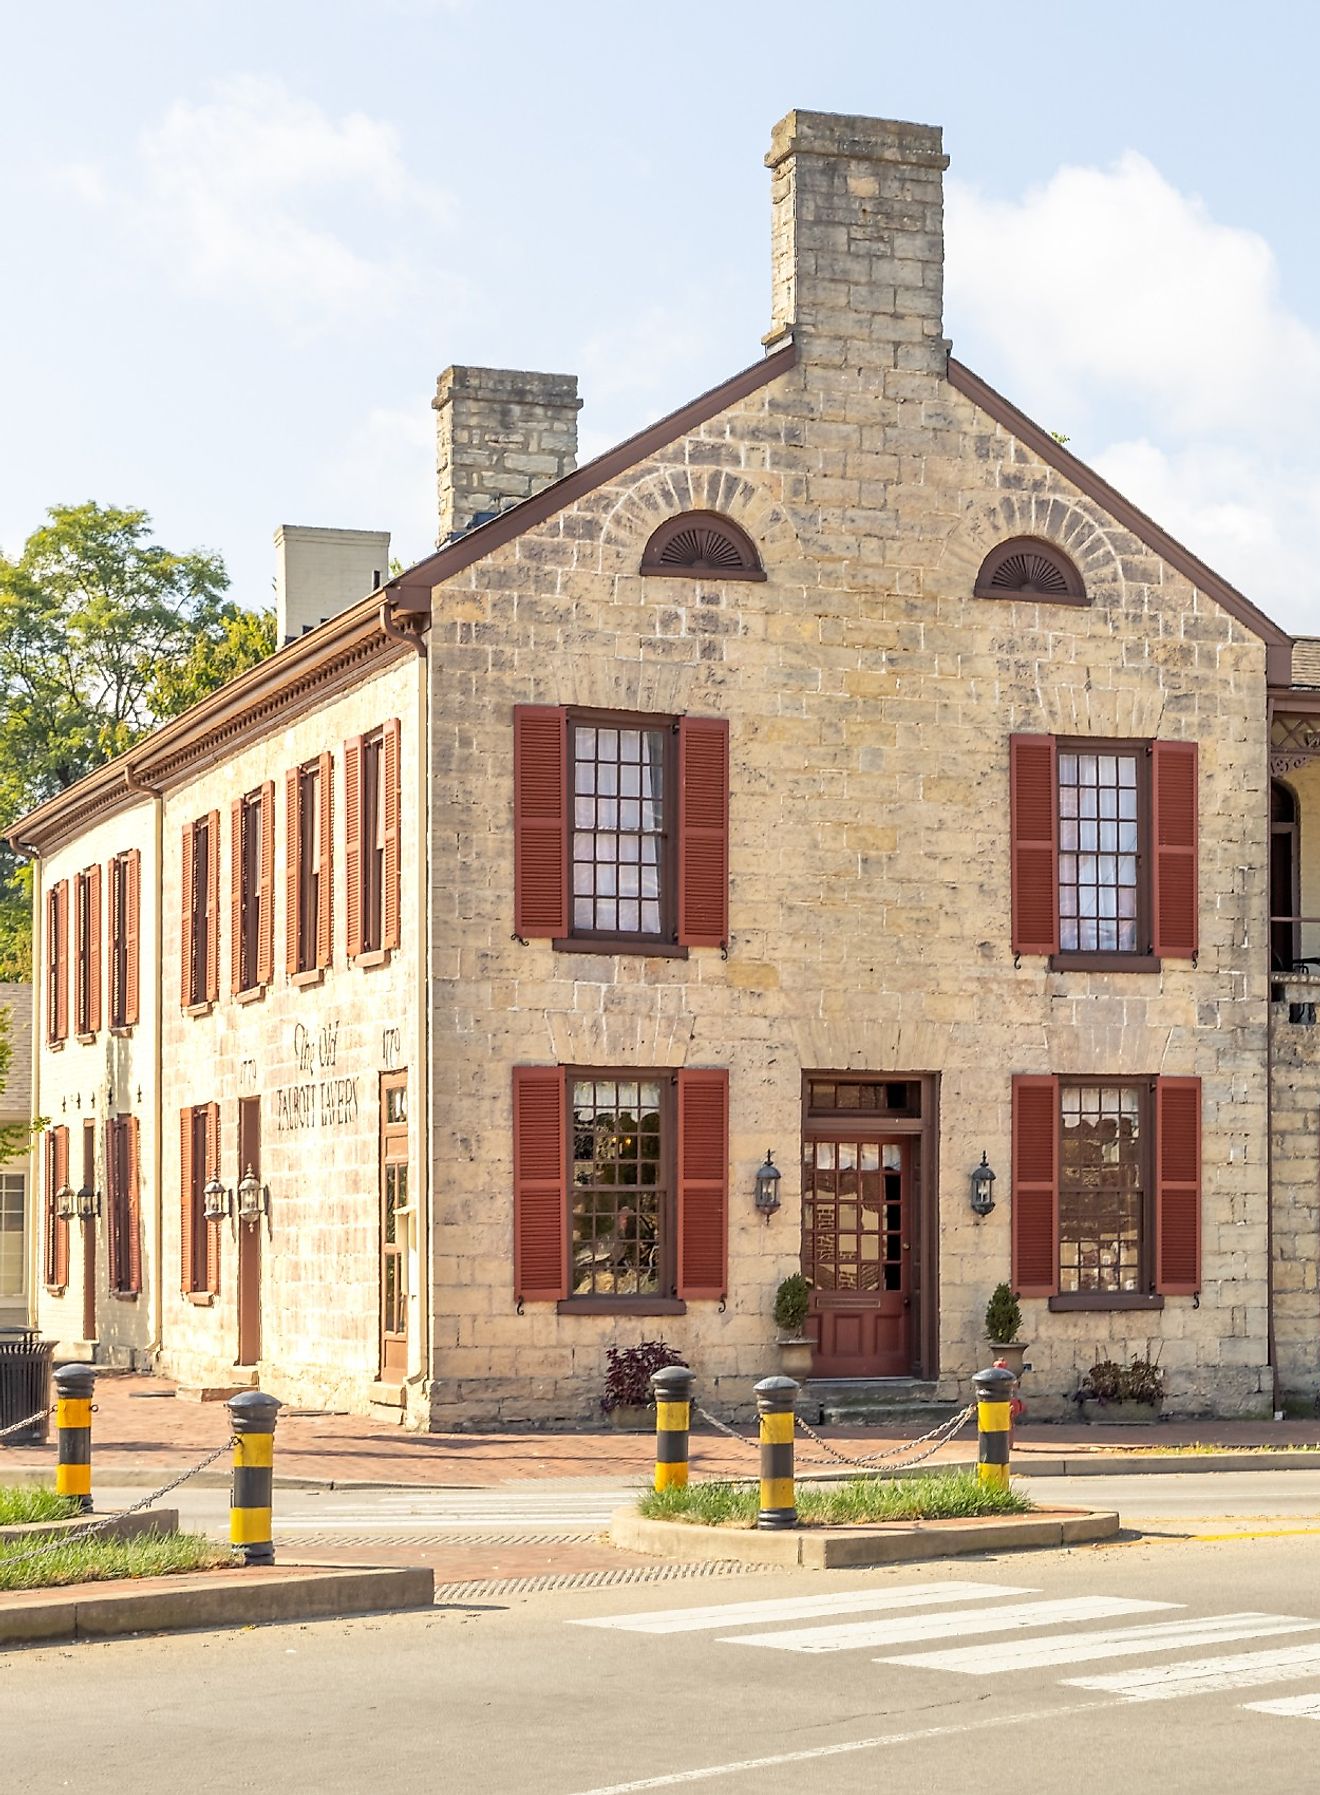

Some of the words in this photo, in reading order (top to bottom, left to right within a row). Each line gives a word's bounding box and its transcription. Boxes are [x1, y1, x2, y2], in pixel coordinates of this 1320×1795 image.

[294, 1022, 315, 1076] The
[318, 1020, 340, 1067] Old
[277, 1083, 316, 1131] TALBOTT
[320, 1076, 360, 1126] TAVERN
